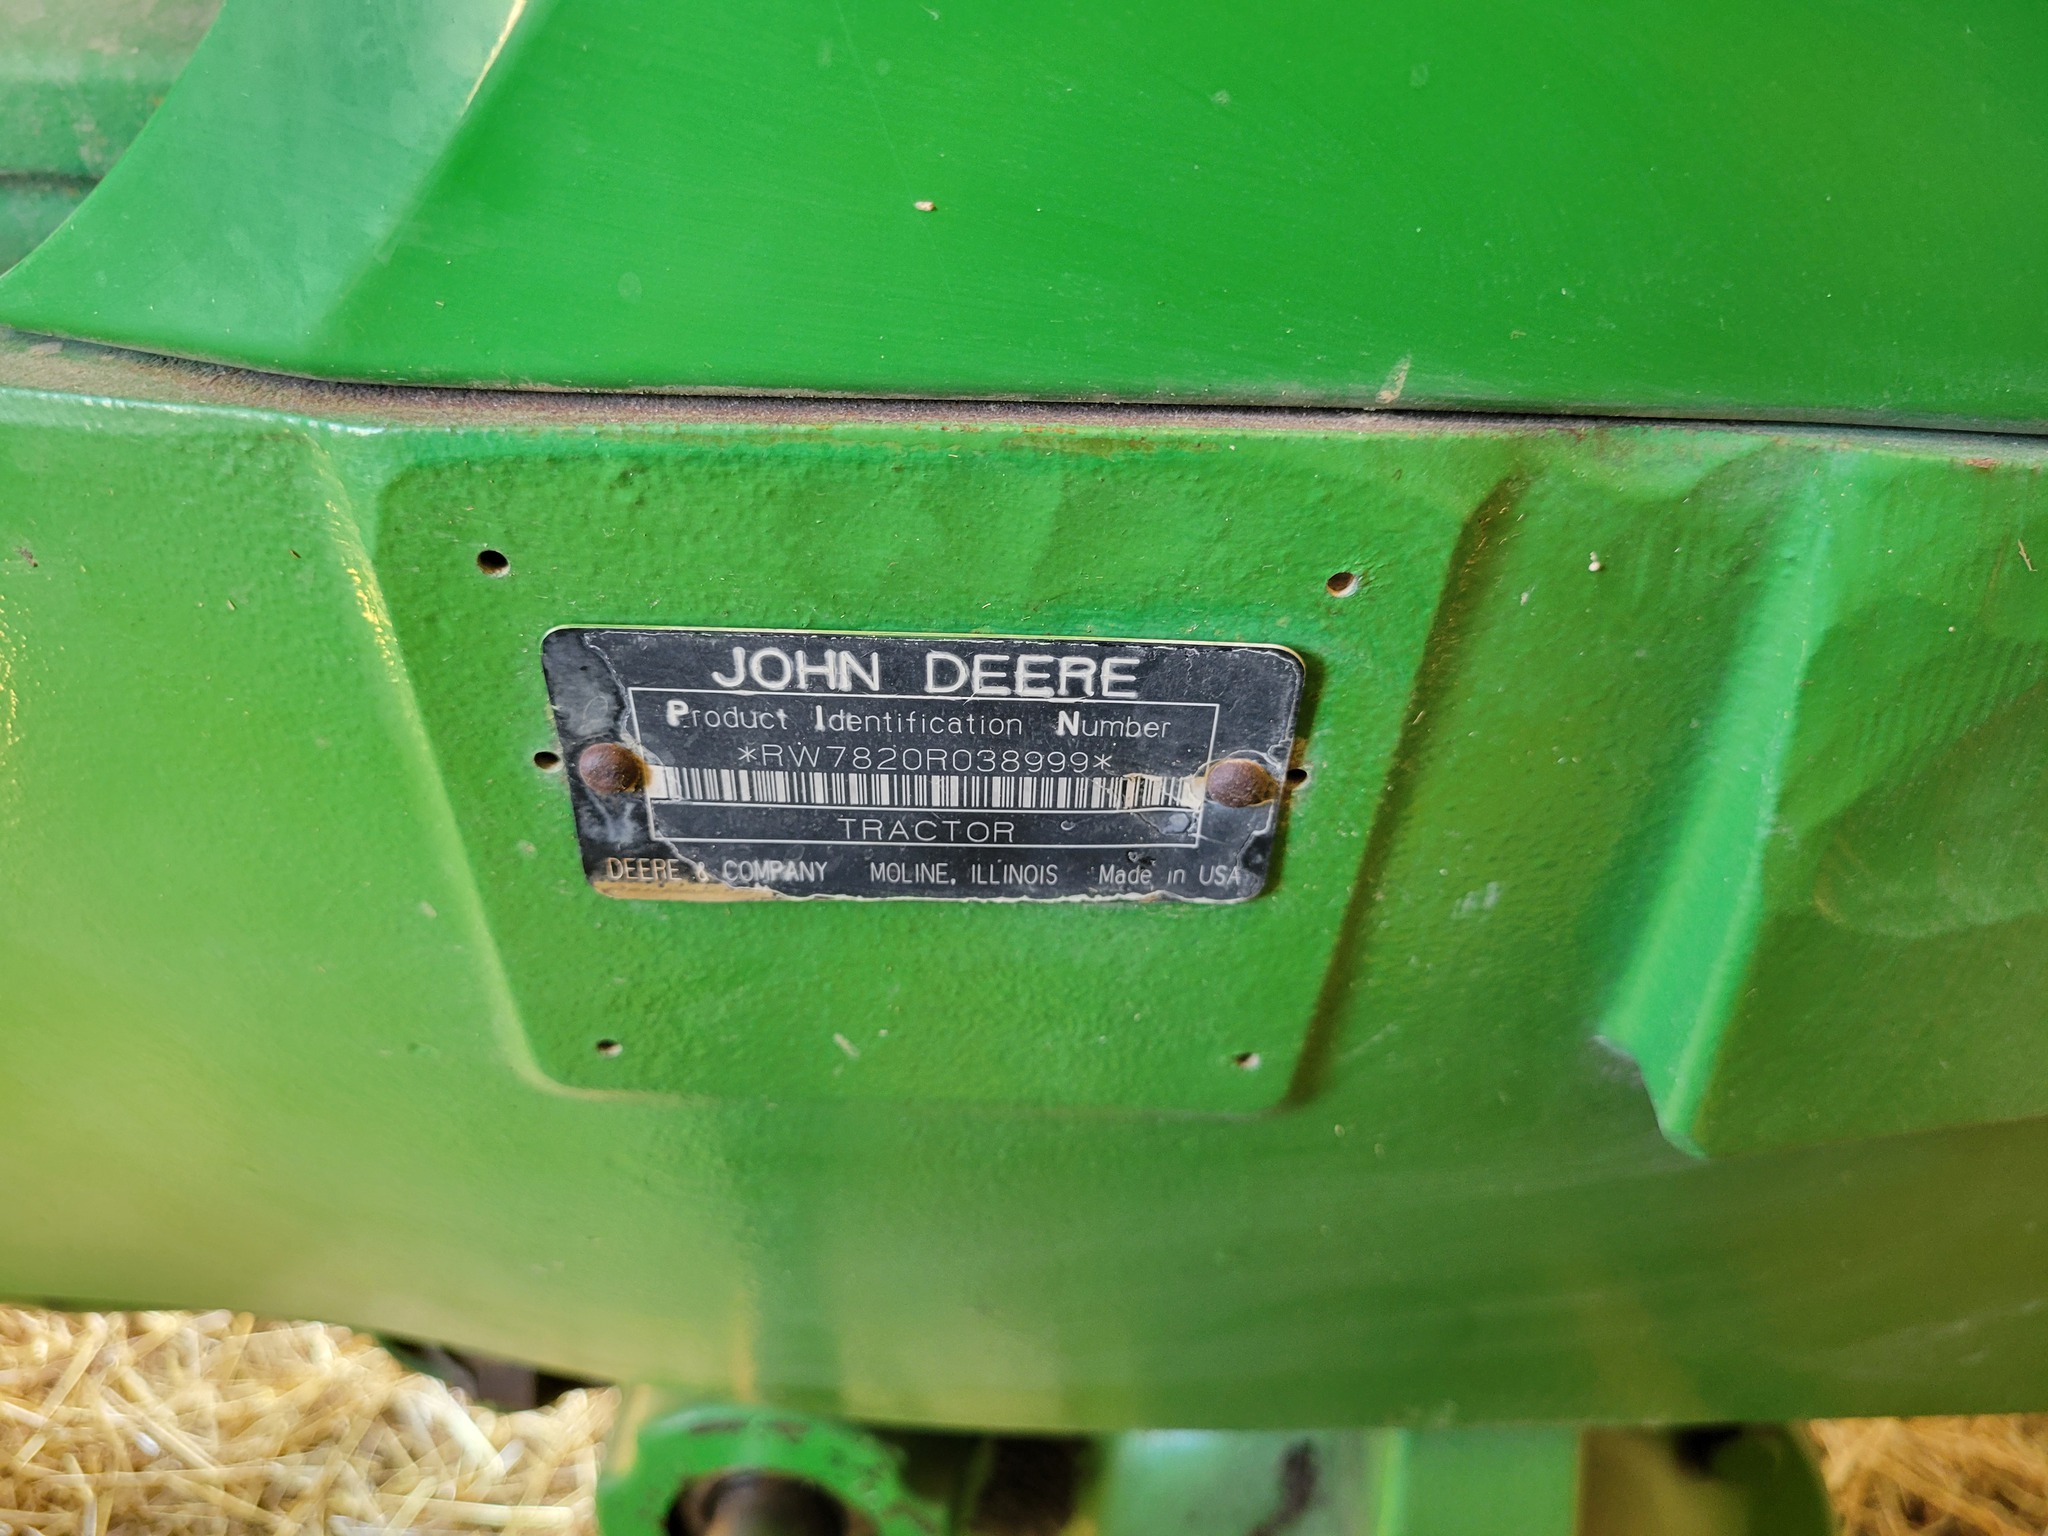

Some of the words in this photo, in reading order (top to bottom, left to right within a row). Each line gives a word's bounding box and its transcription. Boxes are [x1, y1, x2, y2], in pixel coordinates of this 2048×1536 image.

[711, 646, 880, 691] JOHN
[924, 650, 1140, 699] DEERE
[666, 699, 787, 730] Product
[815, 705, 1022, 735] Identification
[1056, 710, 1171, 738] Number
[837, 818, 1014, 843] TRACTOR
[606, 857, 682, 881] DEERE
[722, 859, 827, 883] COMPANY
[870, 862, 956, 886] MOLINE,
[971, 864, 1058, 886] ILLINOIS
[1098, 864, 1153, 885] Made
[1167, 867, 1186, 884] in
[1199, 865, 1241, 886] USA
